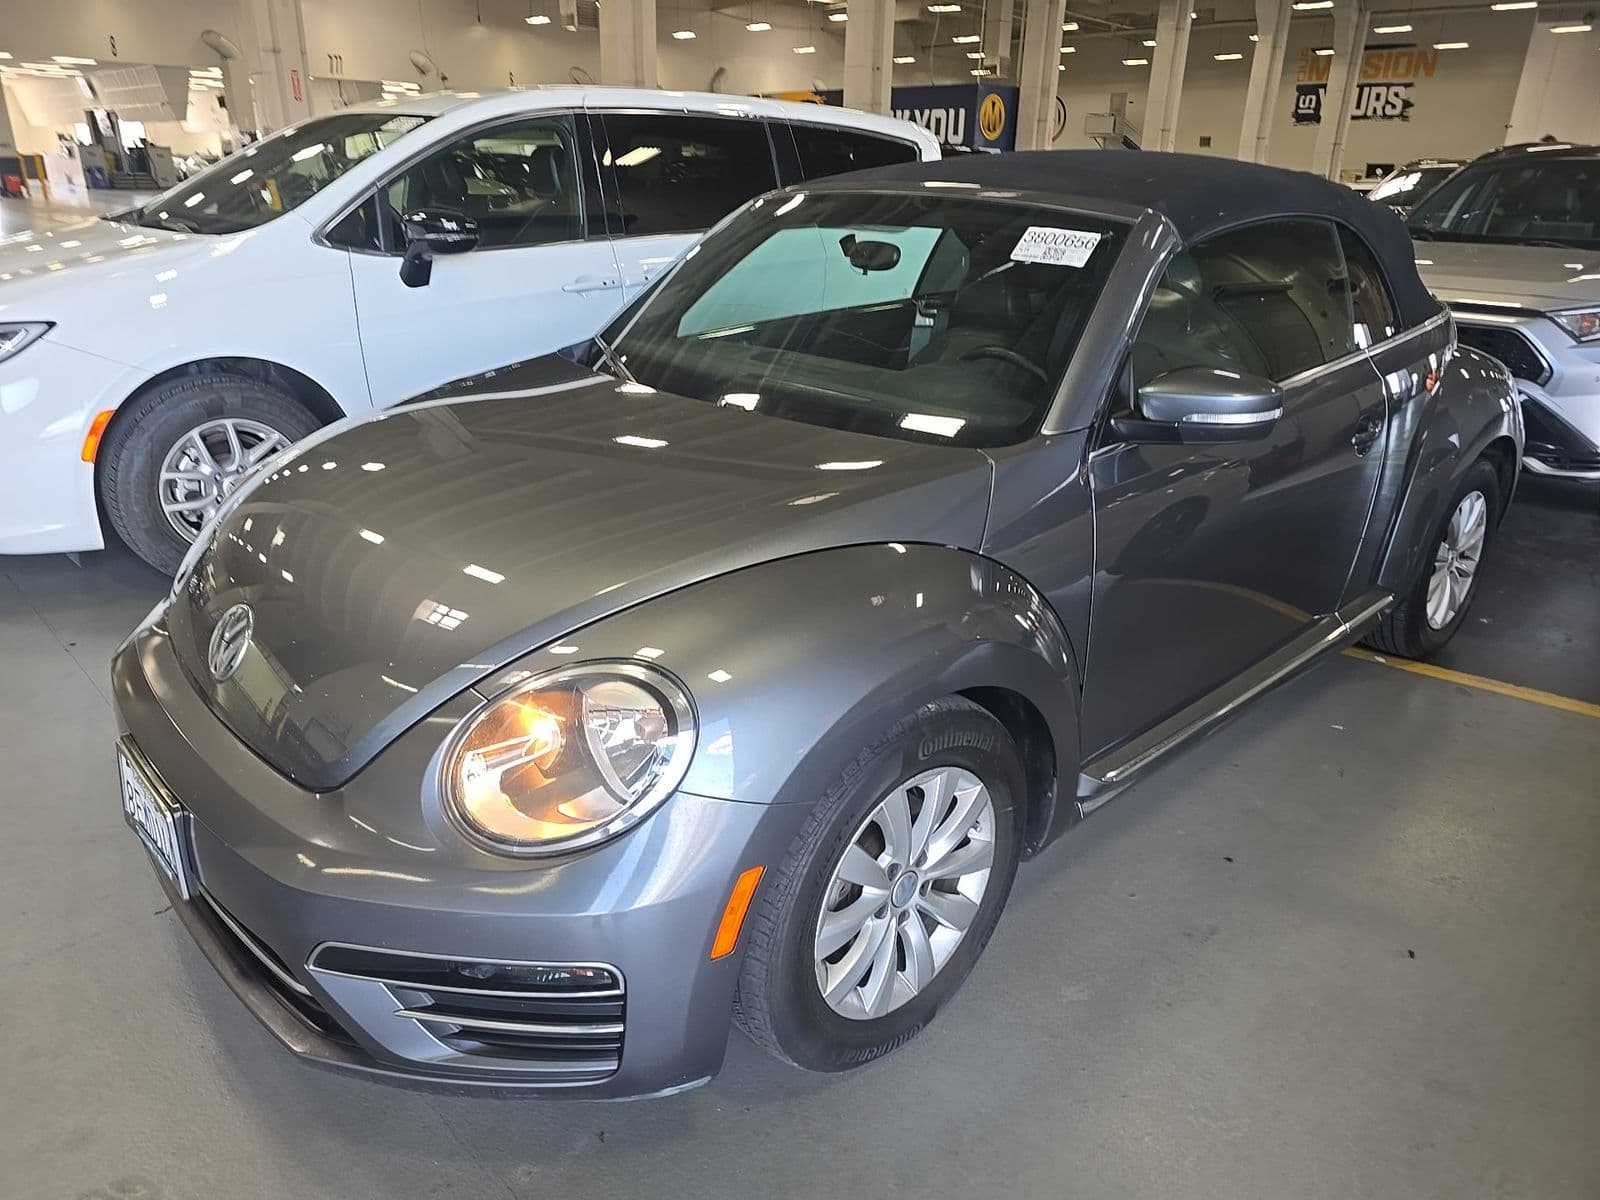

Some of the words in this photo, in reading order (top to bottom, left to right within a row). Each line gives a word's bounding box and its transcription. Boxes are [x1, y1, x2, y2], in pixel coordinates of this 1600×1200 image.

[1307, 47, 1439, 81] MSION
[1318, 86, 1406, 117] YURS
[914, 107, 965, 145] YOU
